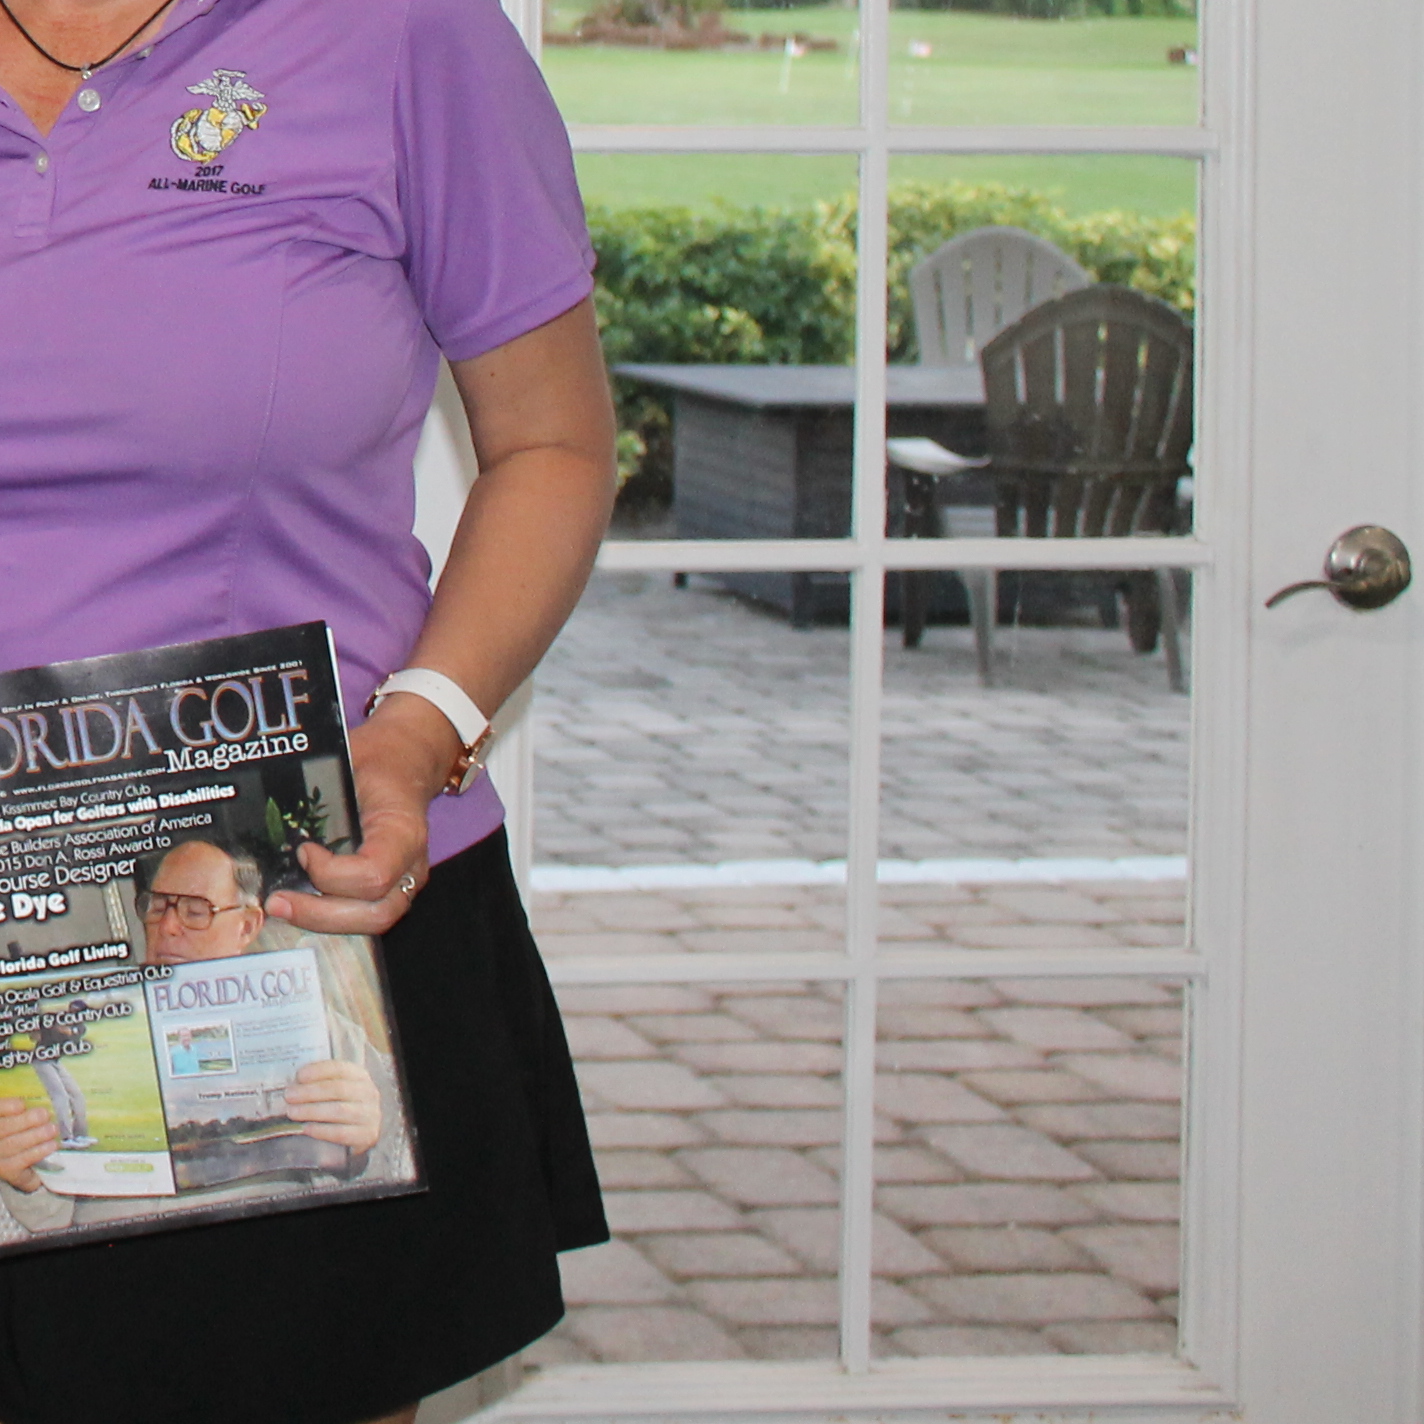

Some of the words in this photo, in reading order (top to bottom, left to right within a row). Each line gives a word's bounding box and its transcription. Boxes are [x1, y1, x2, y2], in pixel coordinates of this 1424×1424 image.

[148, 178, 228, 194] ALL-MARINE
[230, 181, 266, 195] GOLF
[194, 165, 224, 177] 2017
[280, 660, 303, 669] 2001
[170, 669, 310, 746] GOLF
[163, 732, 309, 773] Magazine
[2, 799, 58, 816] Kissimmee
[59, 795, 78, 807] Bay
[80, 789, 123, 805] Country
[125, 783, 151, 798] Club
[14, 815, 51, 832] Open
[54, 810, 74, 824] for
[76, 803, 126, 822] Golfers
[127, 796, 158, 814] with
[158, 784, 235, 807] Disabilities
[11, 838, 61, 855] Builders
[64, 825, 139, 846] Association
[141, 821, 155, 834] of
[158, 813, 212, 832] America
[25, 853, 52, 868] Don
[55, 851, 70, 864] A.
[74, 845, 106, 861] Rossi
[109, 839, 153, 856] Award
[156, 835, 171, 849] to
[54, 858, 136, 885] Designer
[11, 892, 66, 921] Dye
[48, 950, 81, 965] Golf
[83, 942, 128, 961] Living
[5, 987, 40, 1004] Ocala
[41, 982, 67, 998] Golf
[70, 980, 81, 993] &
[83, 971, 143, 992] Equestrian
[144, 965, 173, 981] Club
[154, 974, 258, 1012] FLORIDA
[15, 1015, 41, 1033] Golf
[42, 1014, 54, 1027] &
[56, 1007, 103, 1026] Country
[104, 1002, 132, 1017] Club
[35, 1045, 62, 1061] Golf
[62, 1040, 92, 1056] Club
